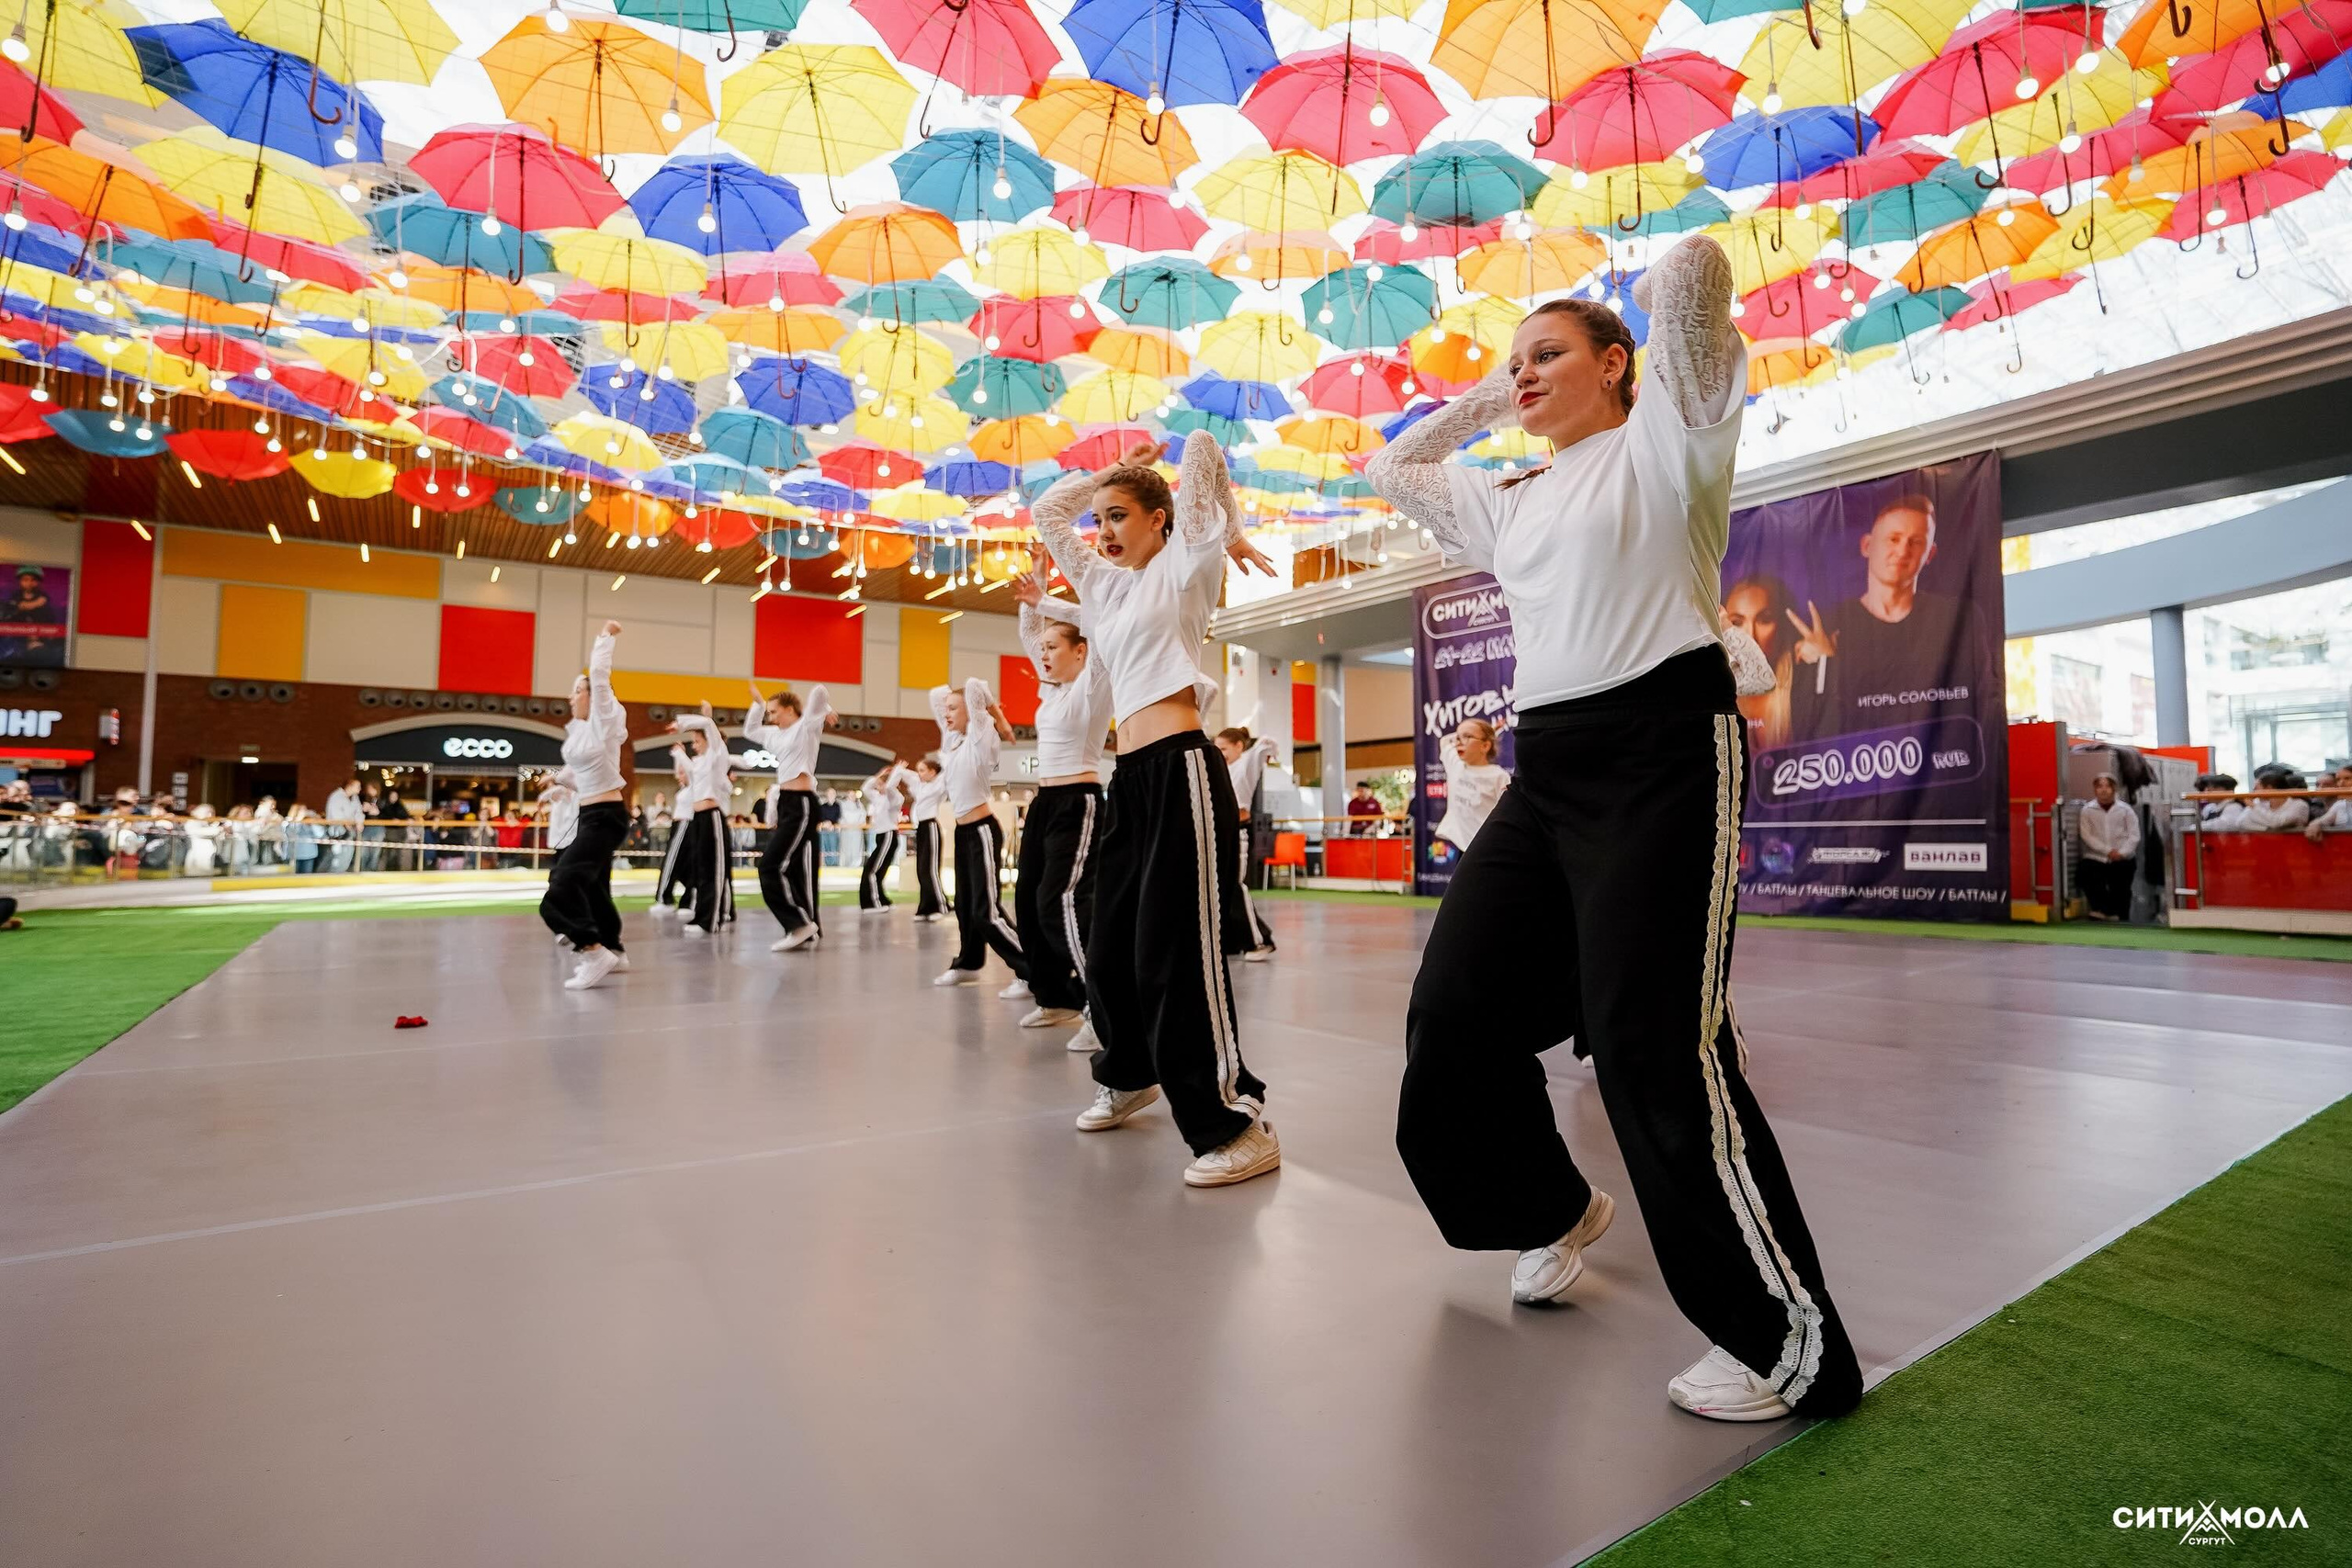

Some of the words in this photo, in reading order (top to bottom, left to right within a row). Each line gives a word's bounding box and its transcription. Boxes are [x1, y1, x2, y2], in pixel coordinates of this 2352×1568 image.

[1858, 692, 1896, 708] ИГОРЬ
[1899, 686, 1969, 705] СОЛОВЬЕВ
[443, 738, 514, 758] ecco
[1773, 737, 1922, 795] 250.000
[1932, 750, 1971, 769] RUB
[1910, 851, 1981, 863] ванлав
[1758, 883, 1796, 896] БАТТЛЫ
[1806, 884, 1899, 900] ТАНЦЕВАЛЬНОЕ
[1903, 886, 1935, 901] ШОУ
[1948, 888, 1997, 903] БАТТЛЫ
